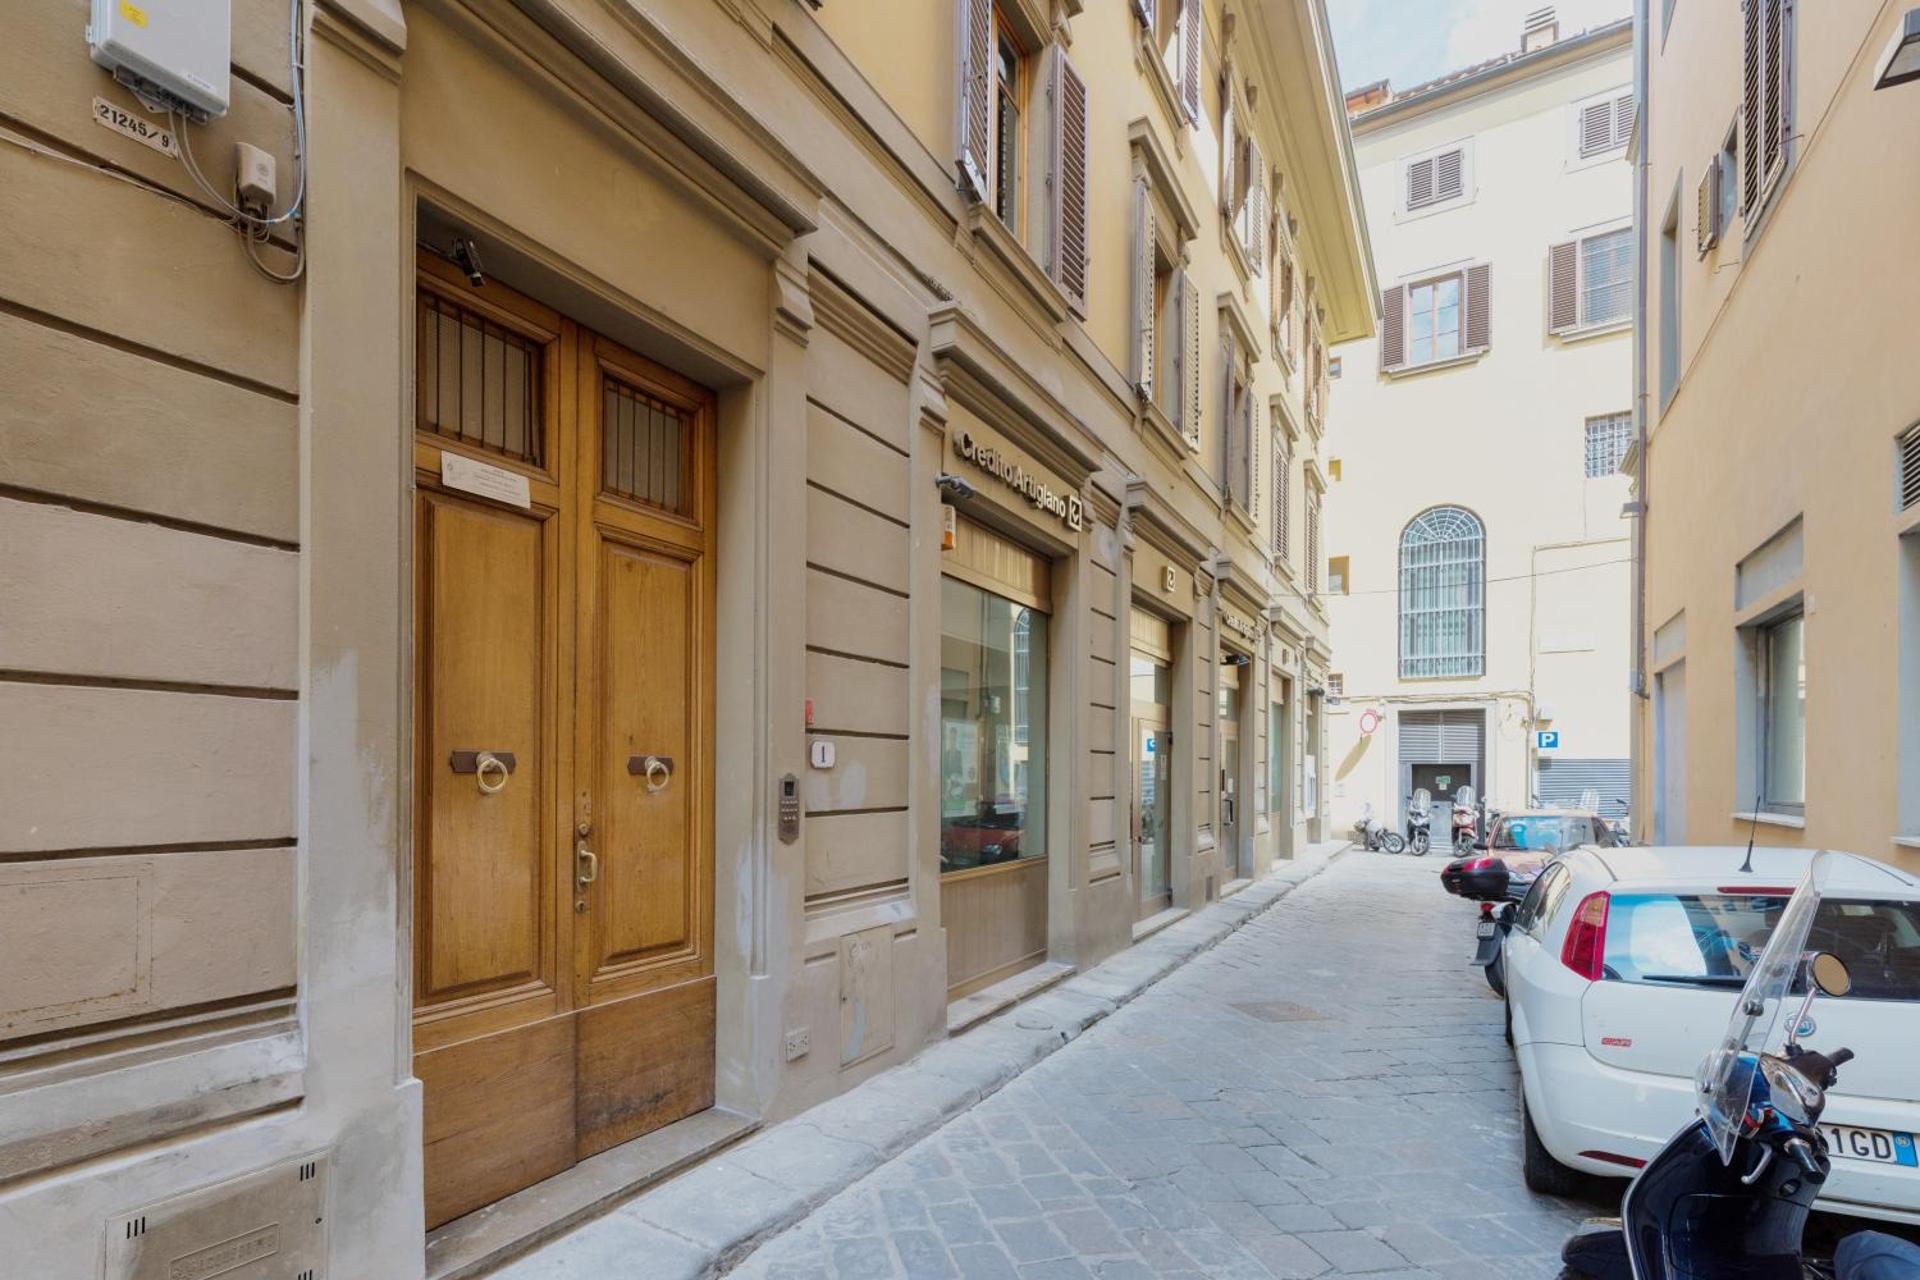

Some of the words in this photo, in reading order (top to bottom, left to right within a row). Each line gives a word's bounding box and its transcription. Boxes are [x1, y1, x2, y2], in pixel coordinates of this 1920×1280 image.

[99, 104, 170, 148] 21245/9
[959, 432, 1013, 483] Credito
[1013, 465, 1066, 519] Artigiano
[1541, 732, 1555, 748] P
